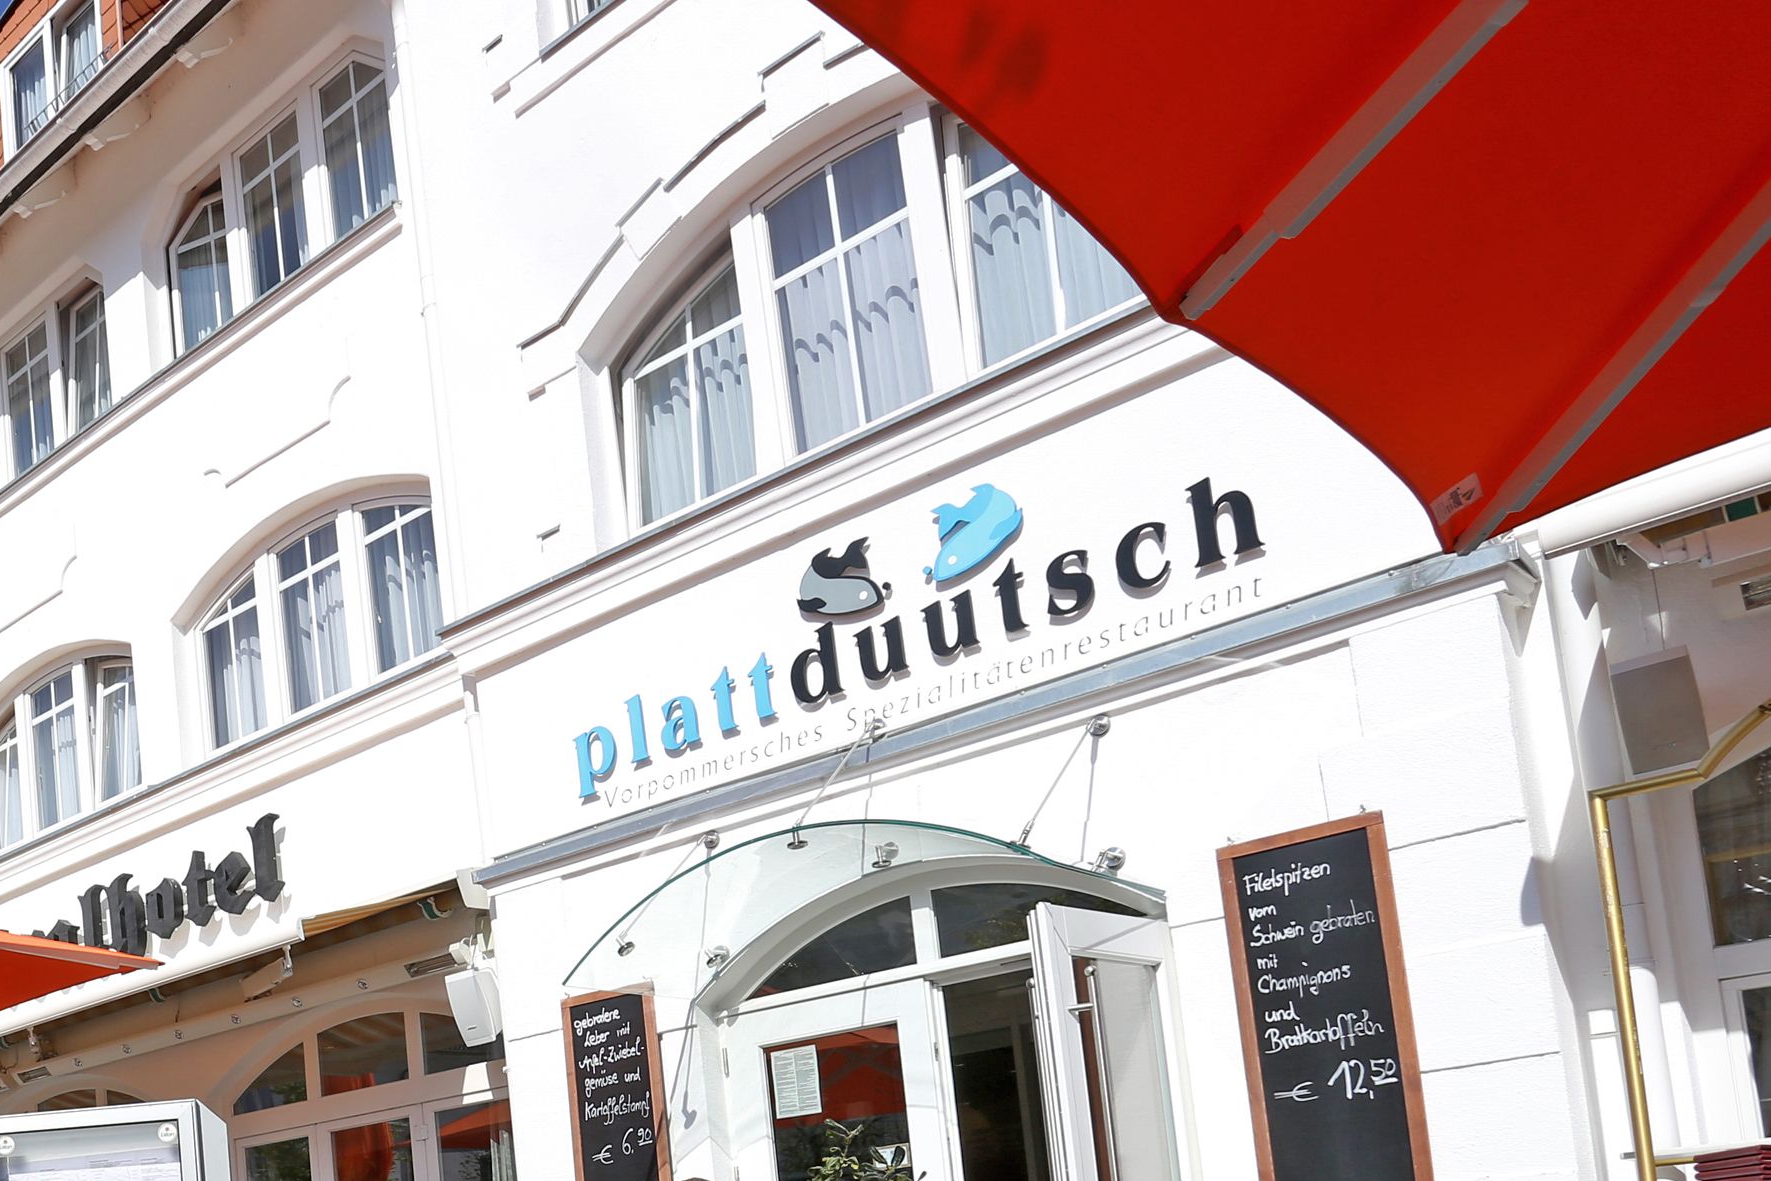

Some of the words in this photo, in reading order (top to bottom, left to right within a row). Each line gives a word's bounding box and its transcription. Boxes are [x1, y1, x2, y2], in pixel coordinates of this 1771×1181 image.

[604, 725, 824, 808] Vorpommersches
[846, 577, 1262, 733] Spezialitätenrestaurant
[1243, 862, 1330, 897] Filetspitzen
[1248, 904, 1277, 922] vom
[1250, 921, 1305, 947] Schwein
[1309, 899, 1376, 945] gebraten
[1256, 954, 1279, 970] mit
[1257, 961, 1351, 998] Champignons
[573, 1007, 621, 1036] gebratene
[1264, 1000, 1301, 1023] und
[584, 1029, 610, 1047] Leber
[616, 1021, 631, 1037] mit
[1264, 1009, 1385, 1054] Bratkartoffeln
[584, 1069, 619, 1098] gemüse
[624, 1066, 641, 1083] und
[1273, 1081, 1320, 1102] €
[585, 1090, 650, 1126] Kartoffelstampf
[591, 1144, 614, 1165] €
